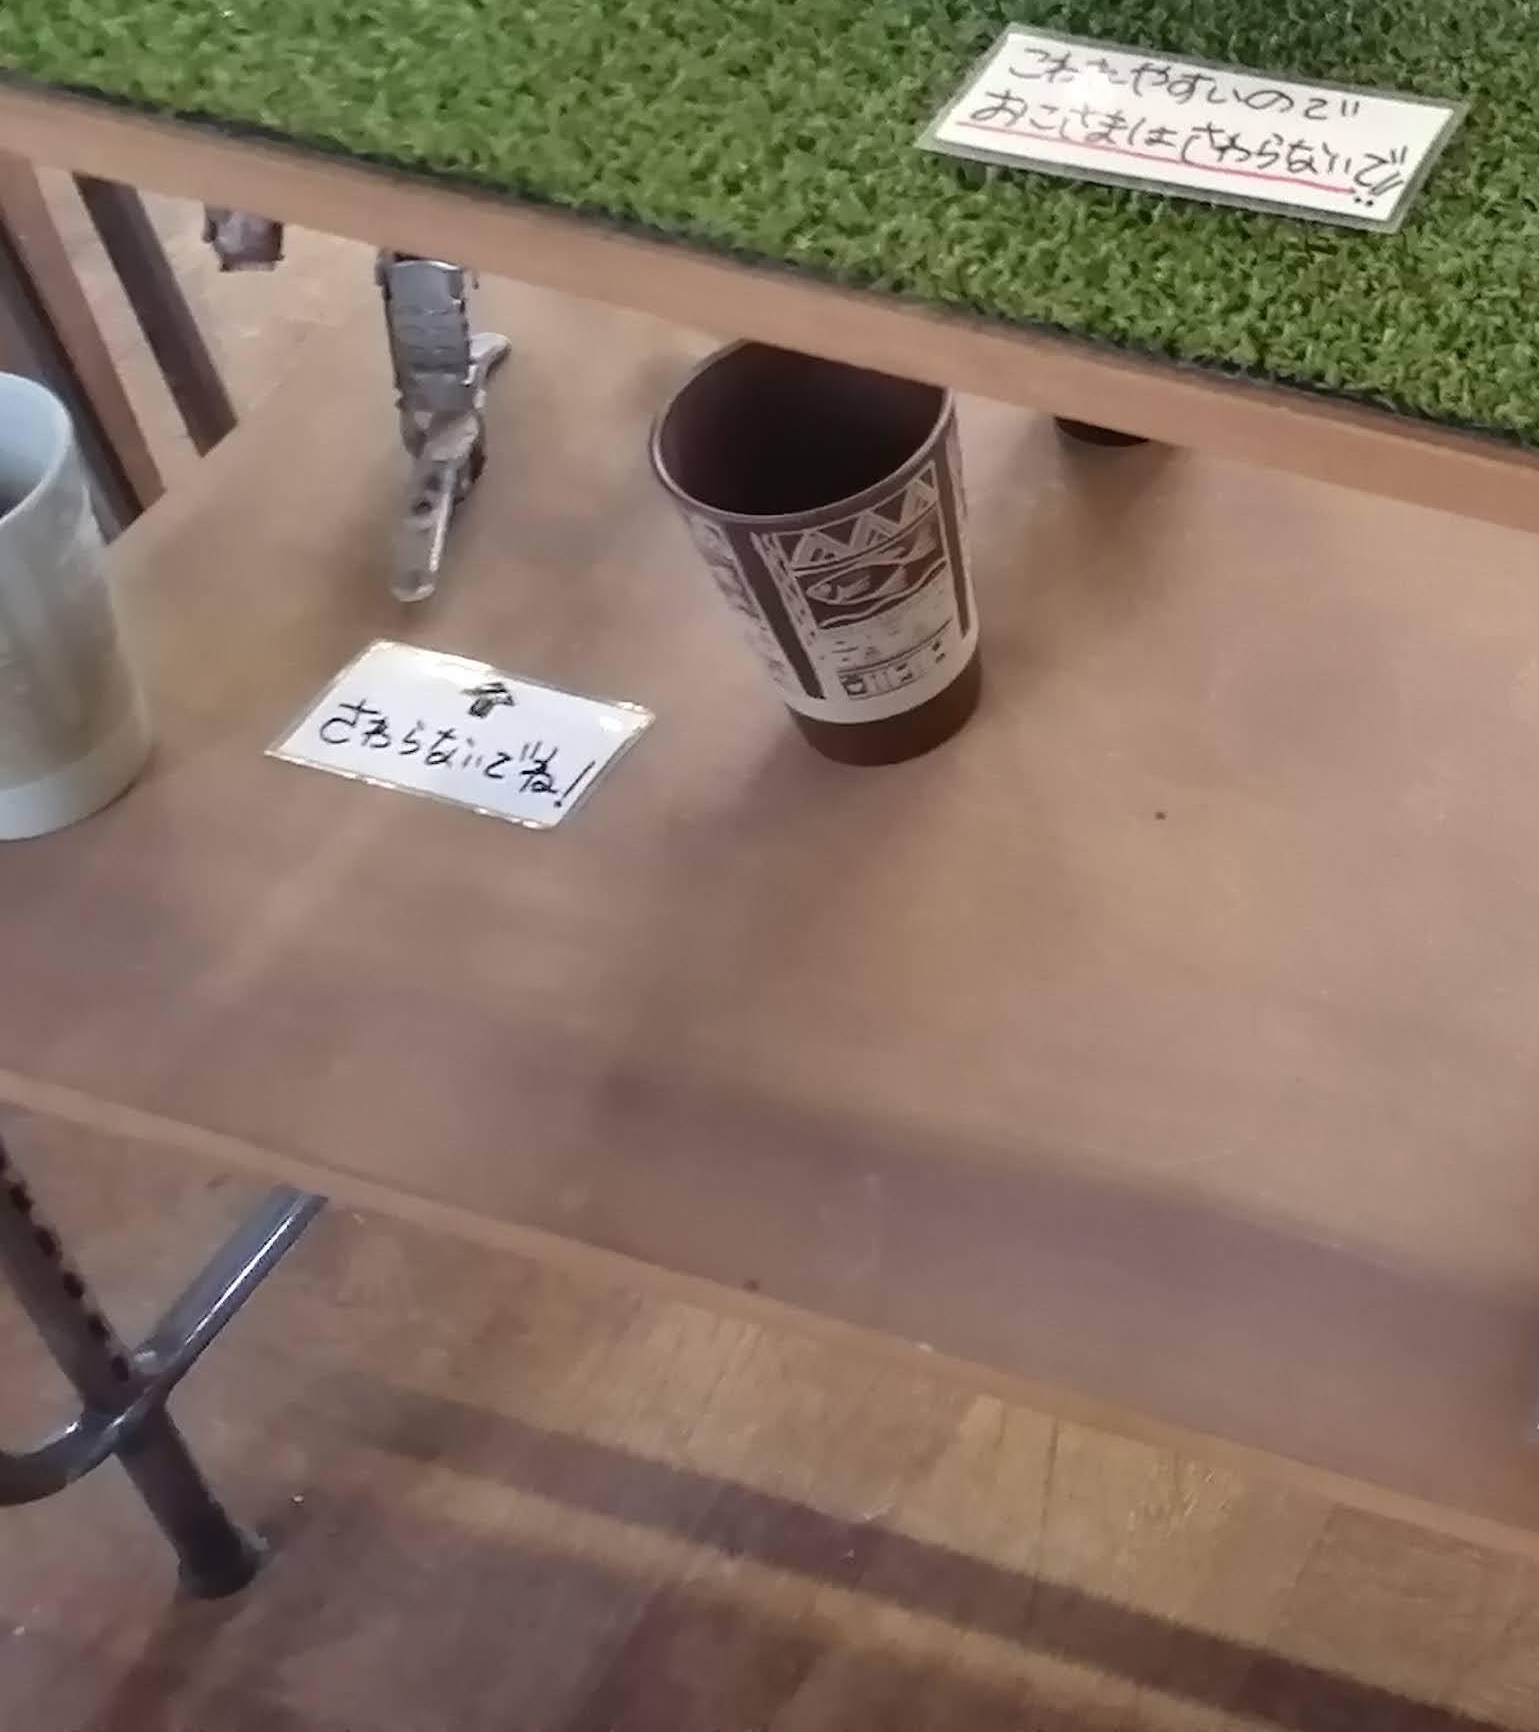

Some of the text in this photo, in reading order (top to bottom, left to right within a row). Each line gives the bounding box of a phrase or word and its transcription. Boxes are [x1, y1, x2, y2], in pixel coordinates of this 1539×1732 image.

[318, 696, 596, 809] さわらないでね!
